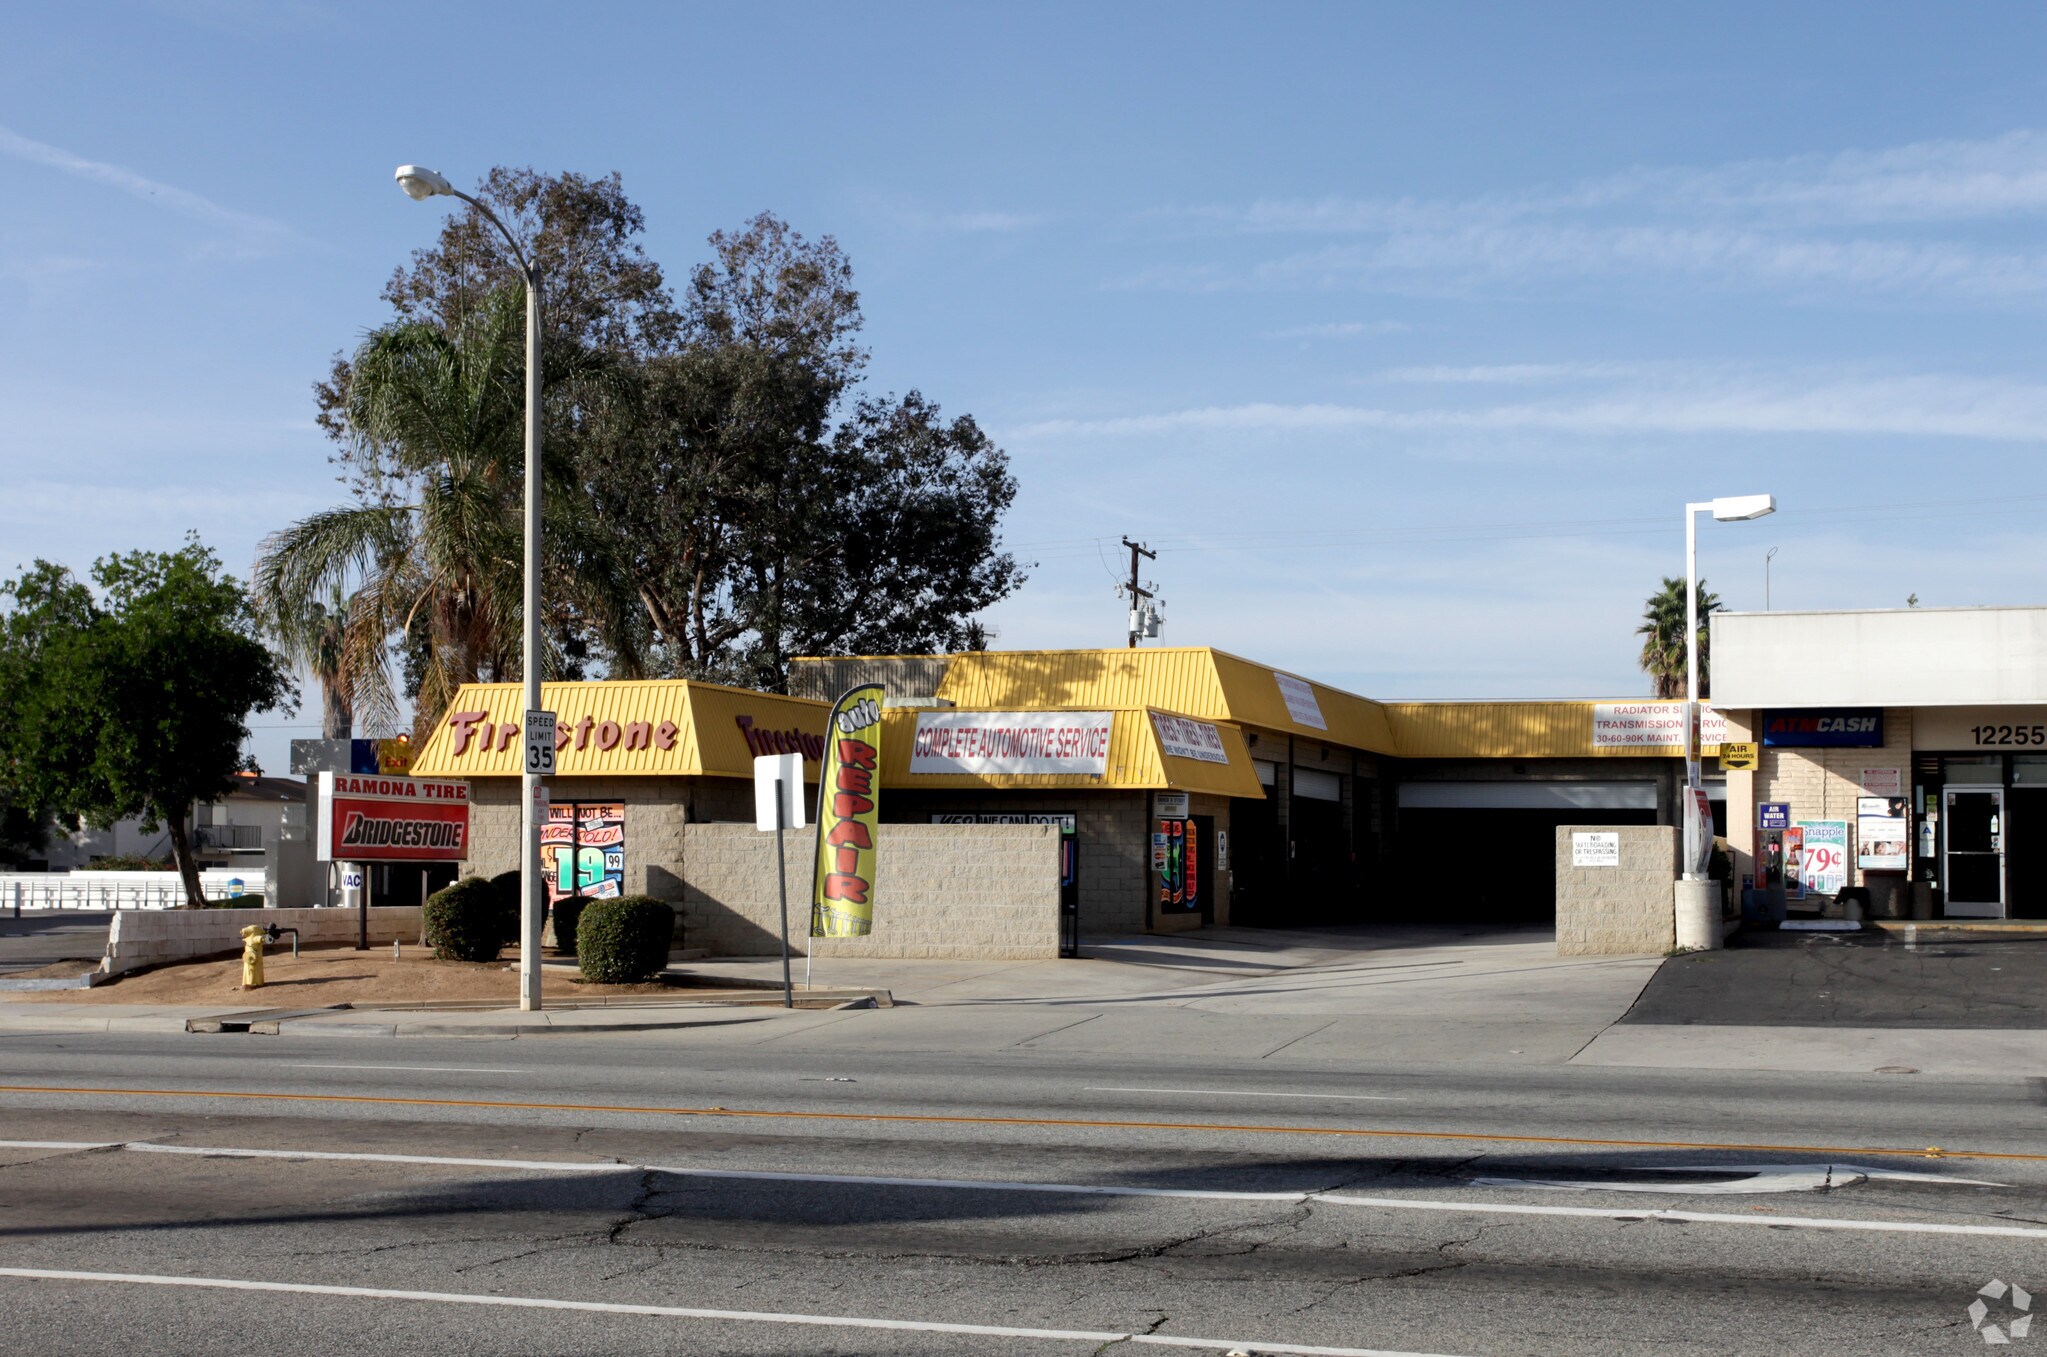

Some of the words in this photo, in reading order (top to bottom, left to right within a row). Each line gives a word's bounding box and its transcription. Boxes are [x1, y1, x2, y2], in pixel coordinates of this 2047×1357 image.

[837, 698, 880, 733] auto
[1614, 706, 1669, 714] RADIATOR
[528, 717, 554, 727] SPEED
[1596, 721, 1683, 729] TRANSMISSION
[450, 710, 679, 757] Firstone
[530, 731, 551, 741] LIMIT
[1596, 735, 1644, 743] 30-60-90K
[1647, 734, 1681, 742] MAINT.
[1971, 725, 2046, 745] 12255
[915, 728, 979, 758] COMPLETE
[979, 728, 1055, 758] AUTOMOTIVE
[1056, 728, 1108, 758] SERVICE
[385, 756, 409, 767] Exit
[529, 745, 553, 769] 35
[335, 778, 416, 796] RAMONA
[423, 784, 466, 799] TIRE
[549, 808, 573, 819] WILL
[577, 808, 598, 818] NOT
[824, 738, 878, 904] REPAIR
[342, 812, 464, 849] BRIDGESTONE
[342, 874, 361, 887] VAC
